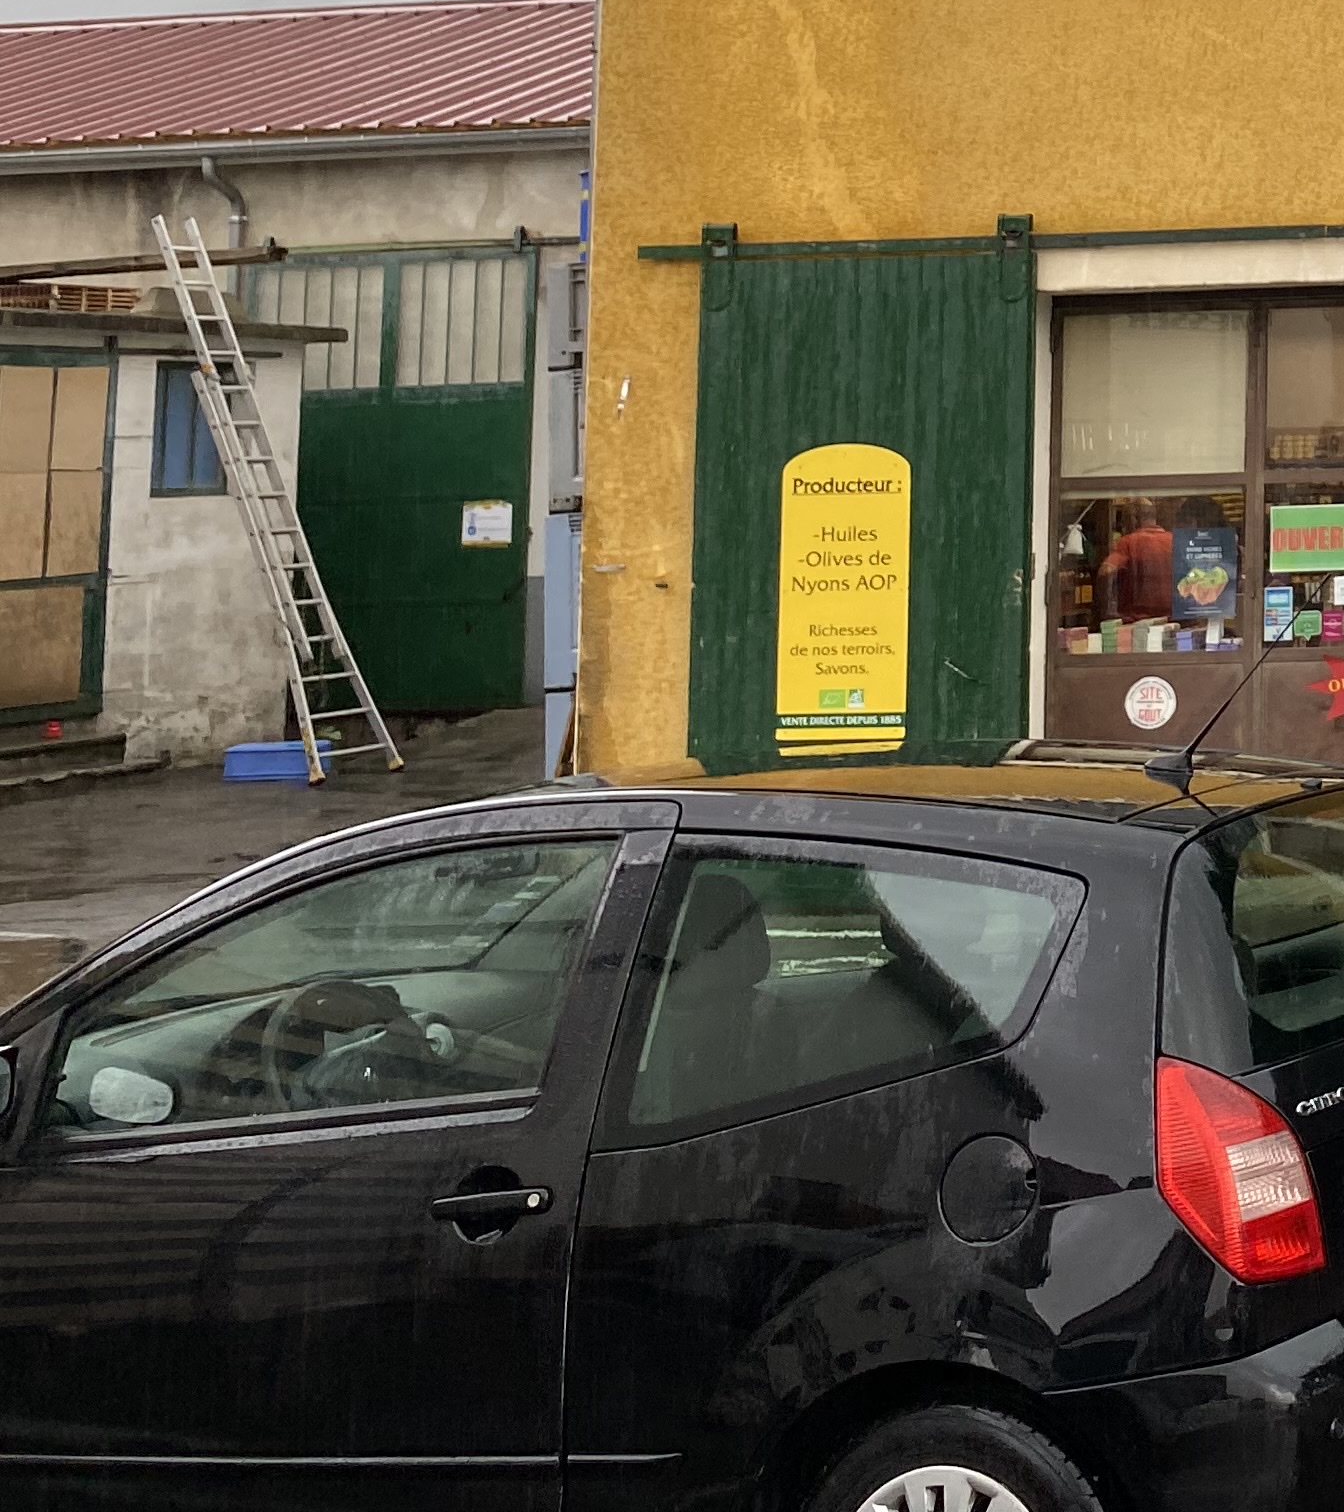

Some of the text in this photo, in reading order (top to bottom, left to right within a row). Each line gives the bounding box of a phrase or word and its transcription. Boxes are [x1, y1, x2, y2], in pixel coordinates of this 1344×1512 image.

[792, 477, 892, 495] Producteur
[868, 551, 892, 566] de
[791, 574, 897, 595] Nyons AOP
[809, 624, 878, 637] Richesses
[790, 643, 808, 656] de
[812, 645, 838, 656] nos
[781, 715, 901, 726] VENTE DIRECTE DEPUIS 1885
